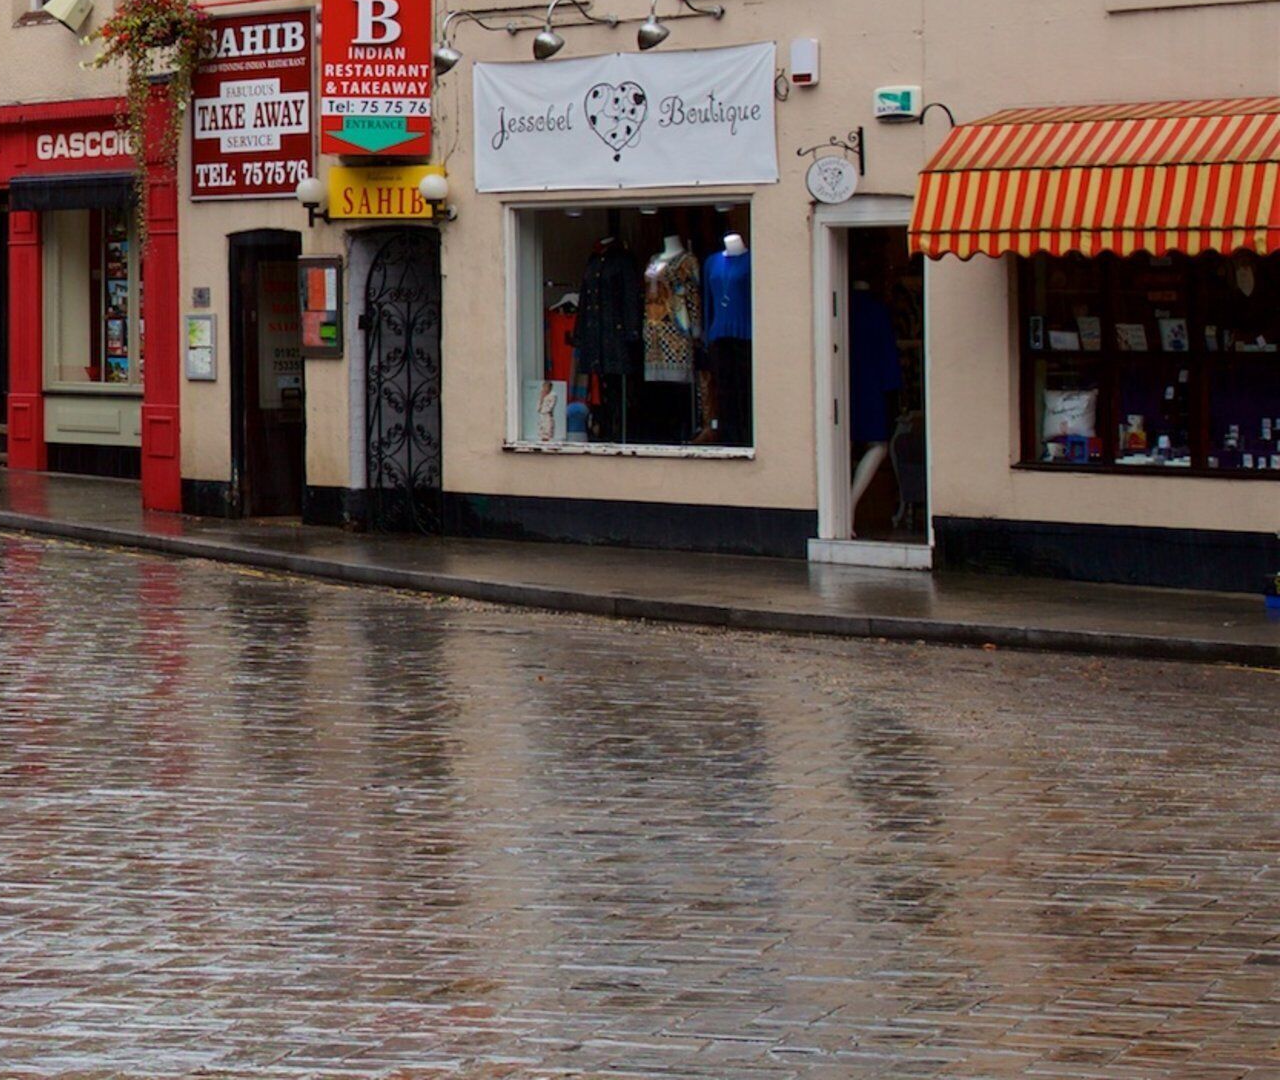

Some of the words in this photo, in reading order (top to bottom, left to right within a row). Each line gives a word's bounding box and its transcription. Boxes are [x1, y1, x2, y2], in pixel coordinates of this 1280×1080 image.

[348, 47, 406, 60] INDIAN
[325, 64, 429, 77] RESTAURANT
[226, 83, 275, 98] FABULOUS
[325, 81, 338, 94] &
[342, 81, 428, 95] TAKEAWAY
[328, 100, 355, 113] Tel:
[361, 100, 379, 114] 75
[384, 100, 403, 114] 75
[409, 100, 428, 114] 76
[658, 90, 762, 135] Boutique
[198, 103, 245, 132] TAKE
[253, 99, 305, 129] AWAY
[345, 120, 404, 130] ENTRANCE
[227, 133, 274, 149] SERVICE
[196, 162, 236, 187] TEL:
[343, 187, 424, 214] SAHIB
